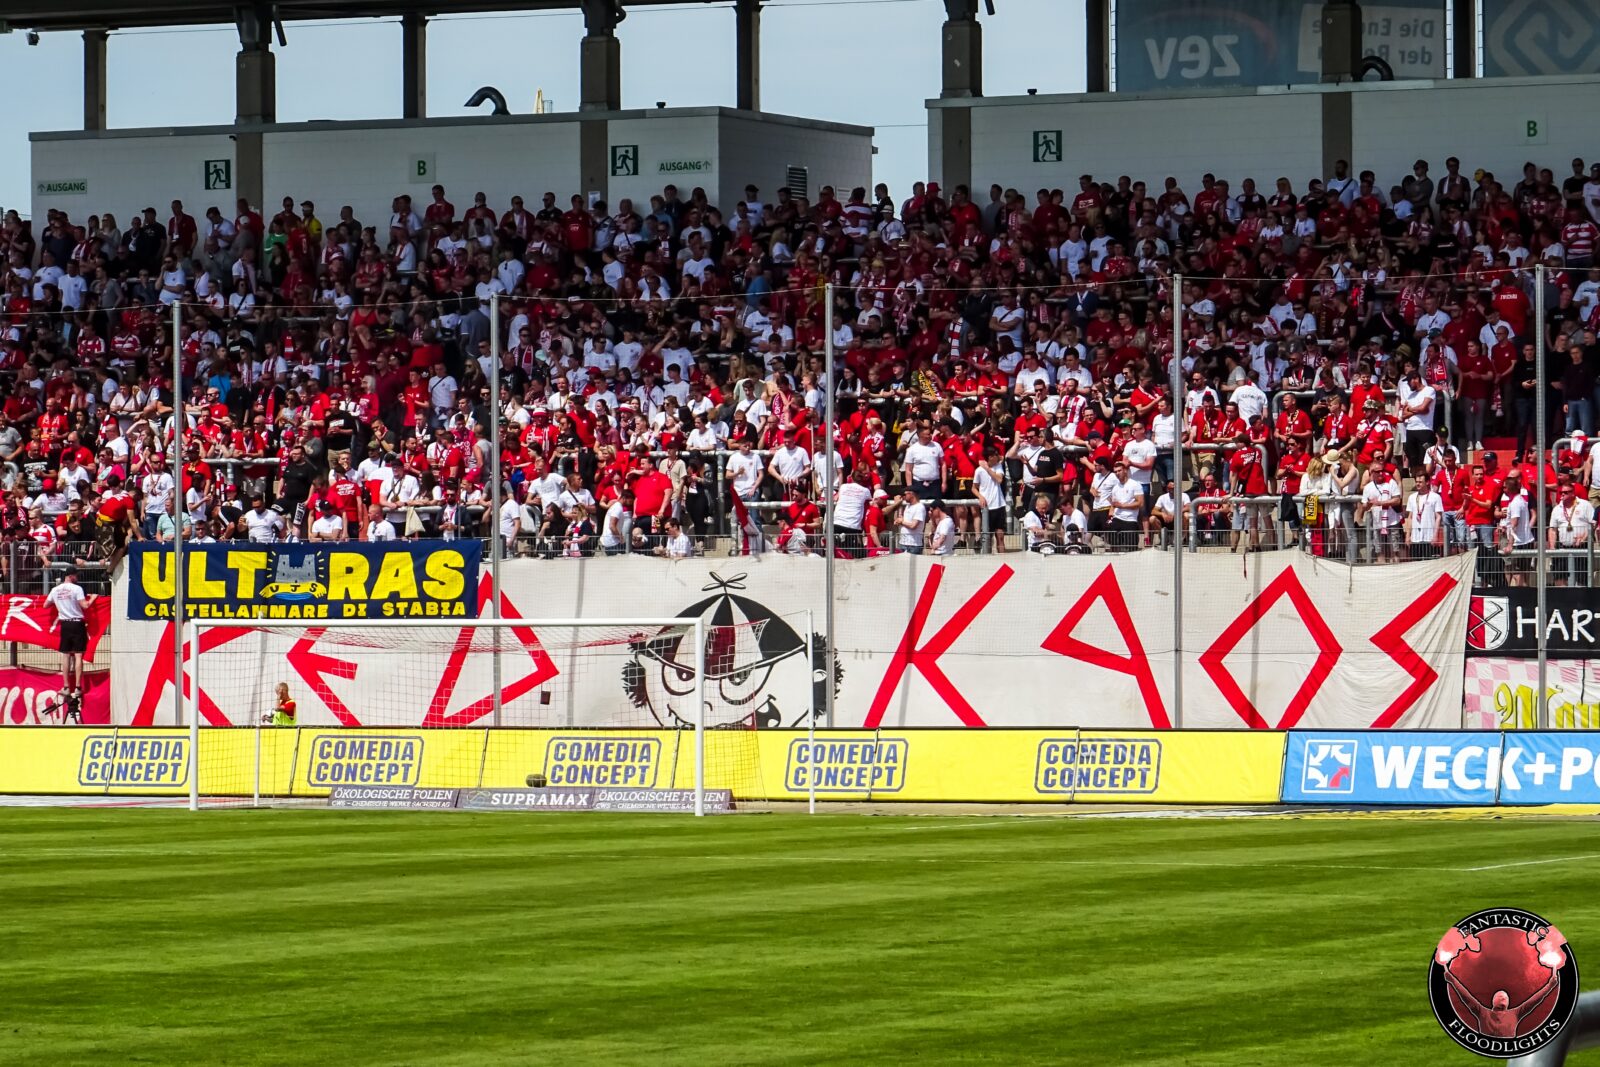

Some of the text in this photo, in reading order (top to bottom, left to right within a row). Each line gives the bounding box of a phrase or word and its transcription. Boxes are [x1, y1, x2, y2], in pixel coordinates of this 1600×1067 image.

[1527, 120, 1537, 137] B
[417, 160, 426, 176] B
[659, 160, 702, 172] AUSGANG
[46, 182, 85, 193] AUSGANG
[343, 603, 367, 617] DI
[382, 601, 466, 617] STABIA
[864, 562, 1458, 728] KAOS
[89, 740, 183, 760] COMEDIA
[319, 740, 414, 760] COMEDIA
[553, 742, 651, 762] COMEDIA
[796, 744, 898, 764] COMEDIA
[1045, 744, 1151, 765] COMEDIA
[86, 762, 181, 782] CONCEPT
[315, 762, 413, 782] CONCEPT
[550, 764, 650, 784] CONCEPT
[1043, 767, 1151, 788] CONCEPT
[1371, 745, 1600, 791] WECK+P
[334, 787, 454, 800] ÖKOLOGISCHE FOLIEN
[491, 793, 590, 806] SUPRAMAX
[598, 789, 726, 802] ÖKOLOGISCHE FOIEN
